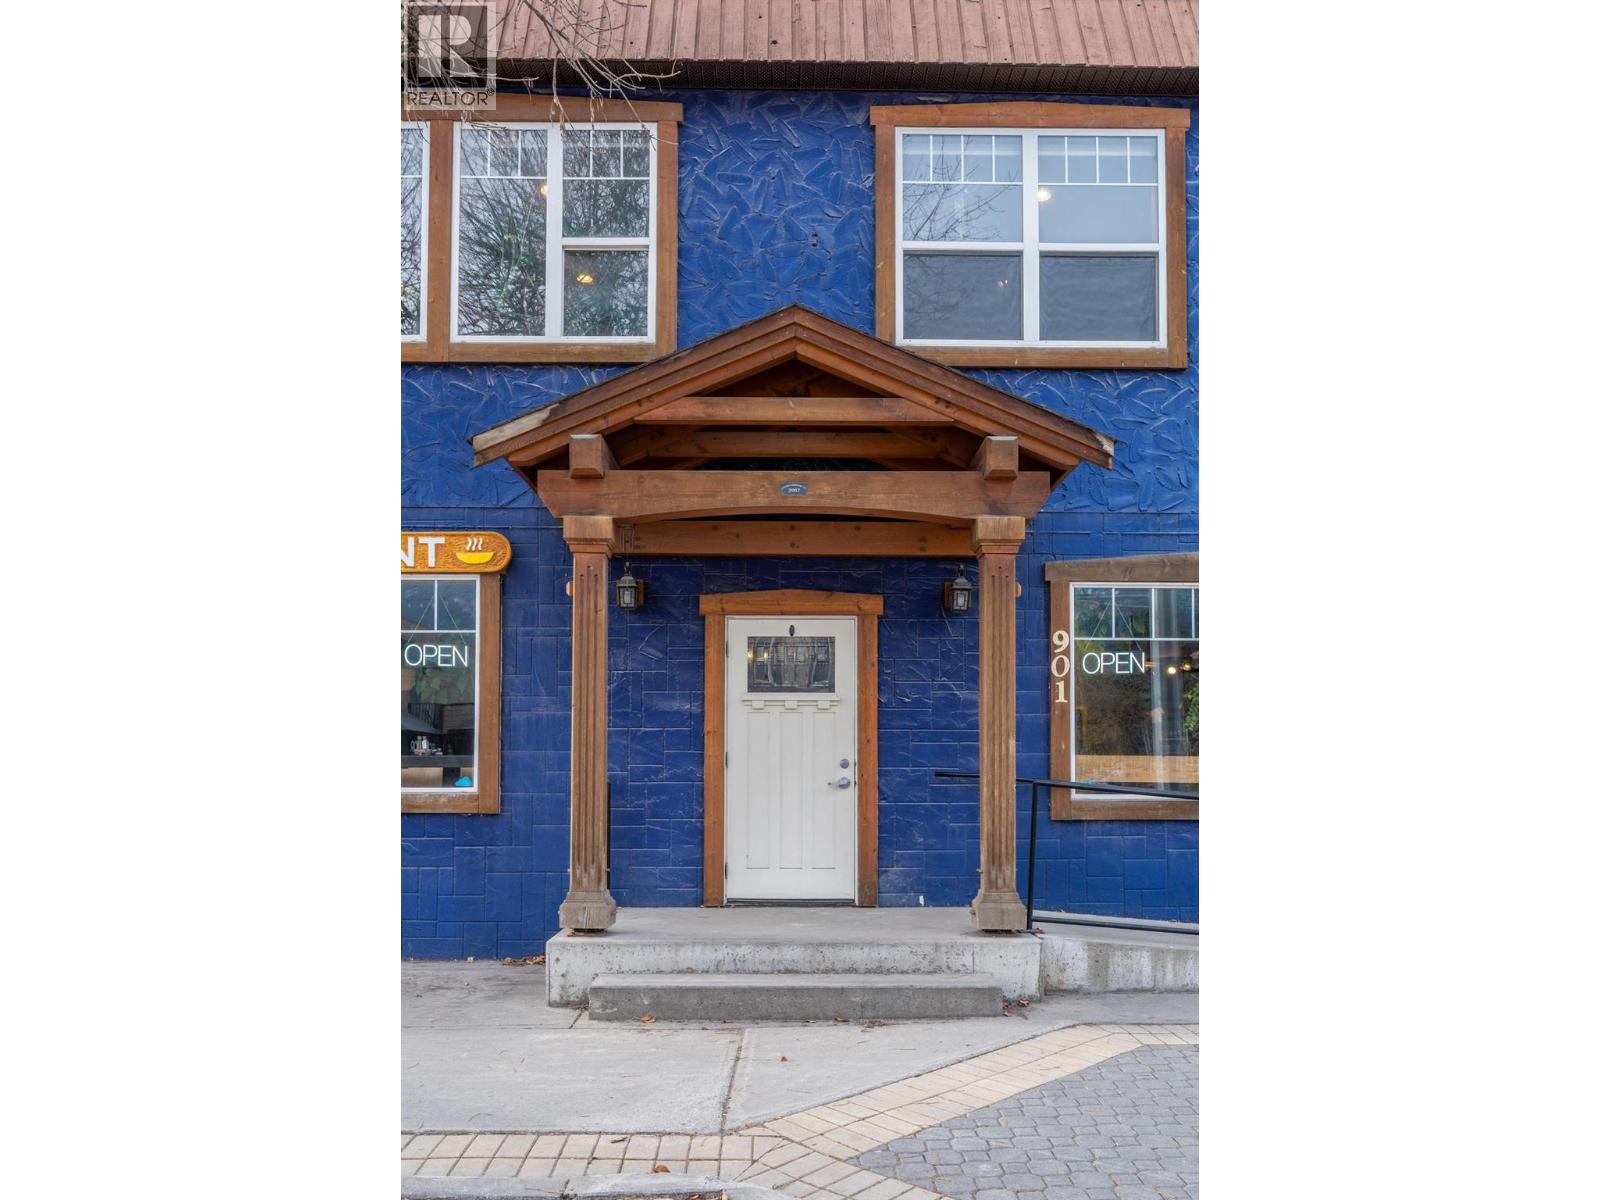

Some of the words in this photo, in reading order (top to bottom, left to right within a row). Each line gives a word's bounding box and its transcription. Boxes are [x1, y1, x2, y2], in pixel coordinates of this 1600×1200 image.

[404, 643, 469, 668] OPEN
[1051, 630, 1070, 703] 901
[1082, 651, 1145, 675] OPEN
